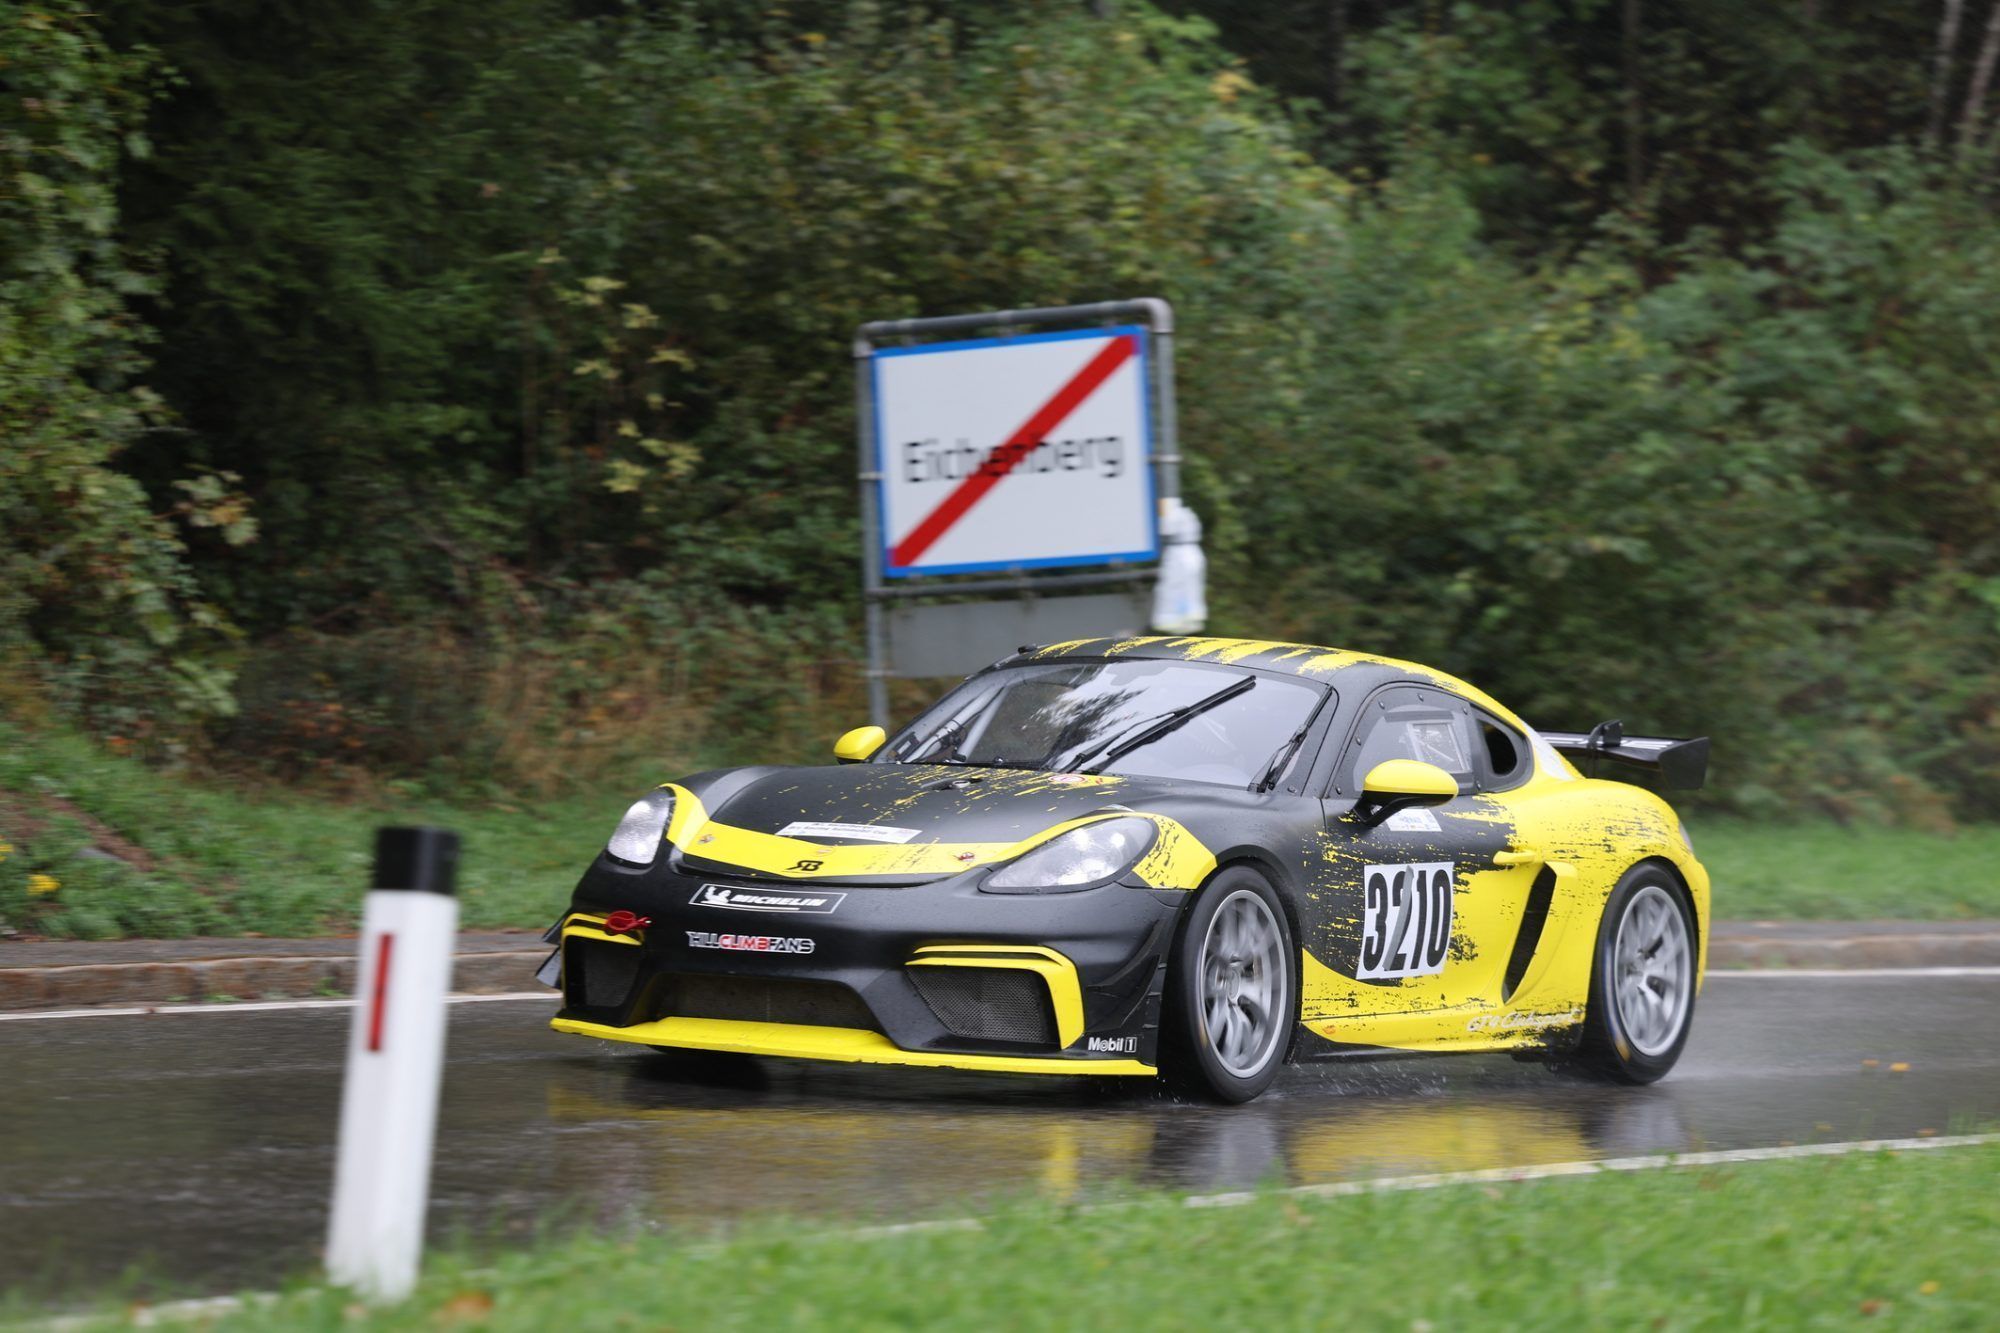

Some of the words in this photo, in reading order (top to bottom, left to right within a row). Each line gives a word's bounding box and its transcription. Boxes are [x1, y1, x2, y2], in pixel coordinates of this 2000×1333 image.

[903, 436, 1123, 483] Eichenberg
[730, 894, 828, 907] MICHELIN
[1362, 869, 1452, 972] 3210
[1088, 1036, 1124, 1052] Mobil
